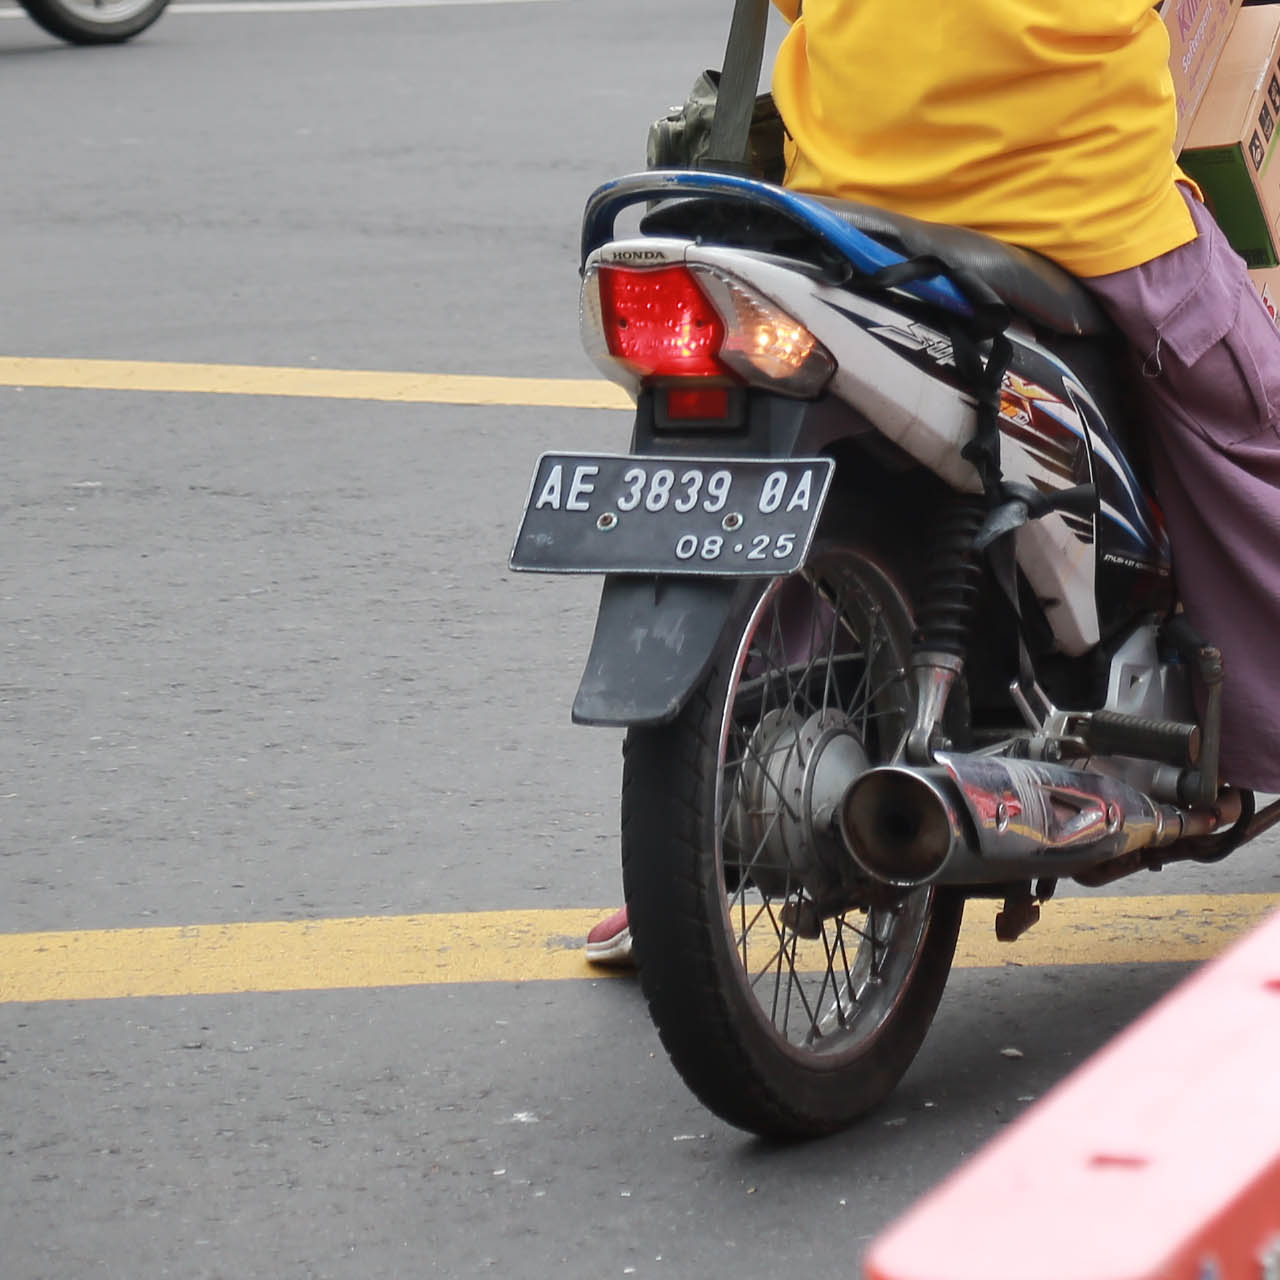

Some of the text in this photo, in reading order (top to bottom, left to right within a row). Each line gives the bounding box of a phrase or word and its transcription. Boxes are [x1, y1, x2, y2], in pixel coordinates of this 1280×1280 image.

[613, 251, 666, 260] HONDA
[535, 465, 599, 512] AE
[616, 468, 733, 513] 3839
